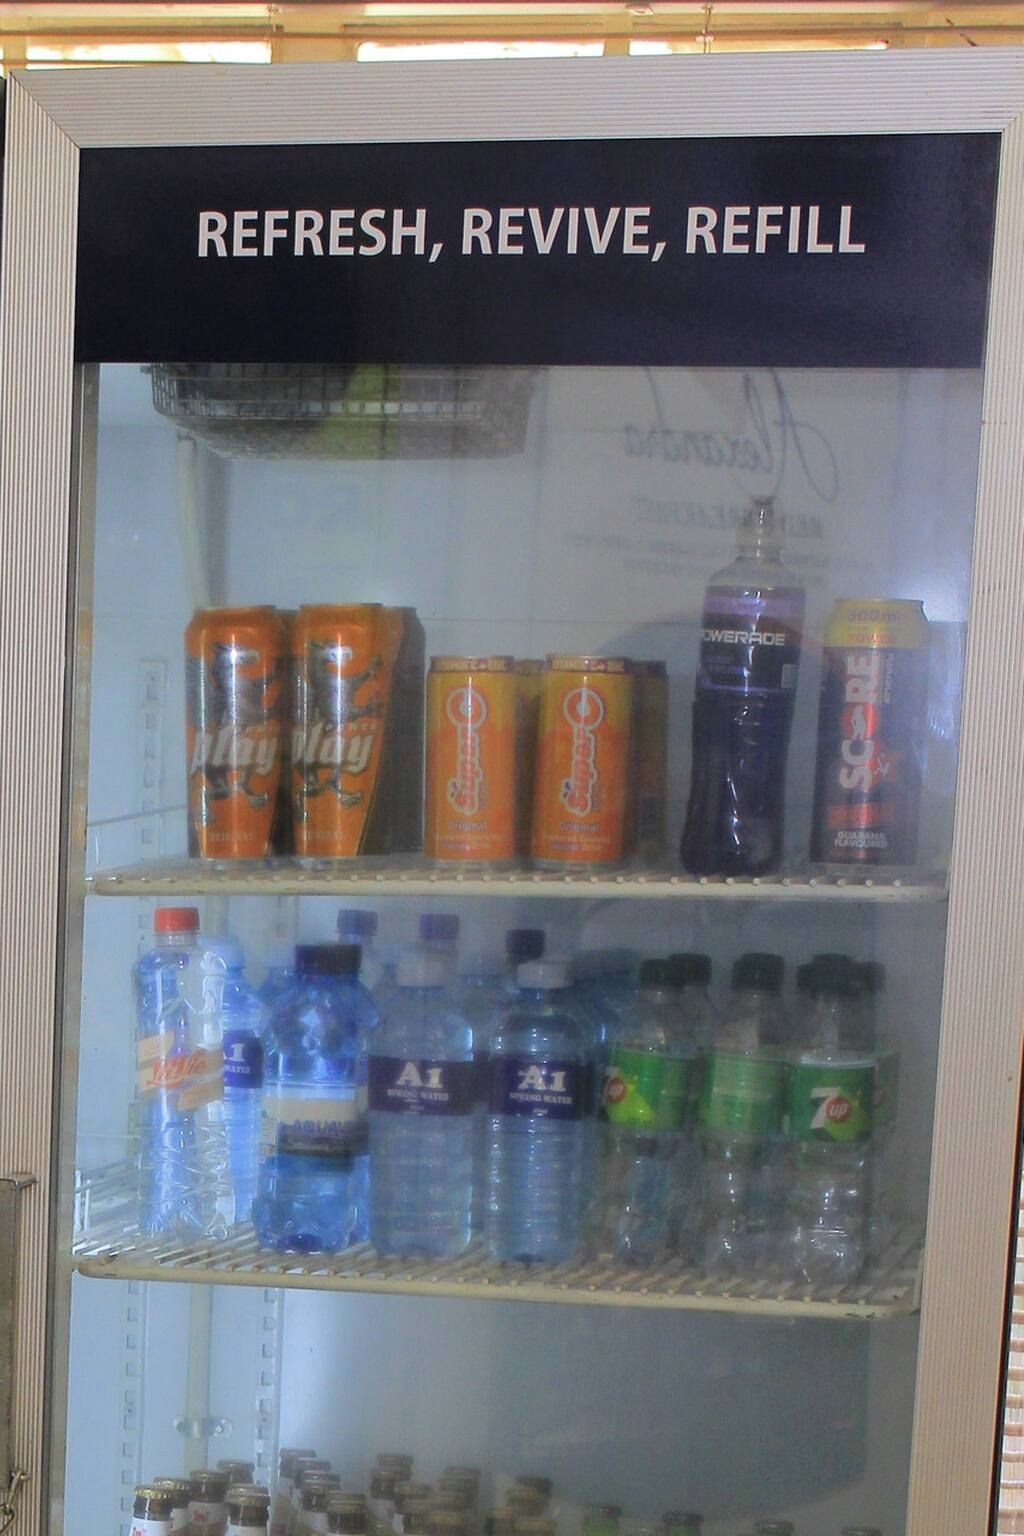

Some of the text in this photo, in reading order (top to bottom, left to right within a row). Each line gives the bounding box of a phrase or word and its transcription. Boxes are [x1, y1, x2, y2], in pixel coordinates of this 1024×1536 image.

[197, 204, 866, 263] REFRESH, REVIVE, REFILL
[395, 1061, 443, 1089] A1
[517, 1064, 567, 1092] A1
